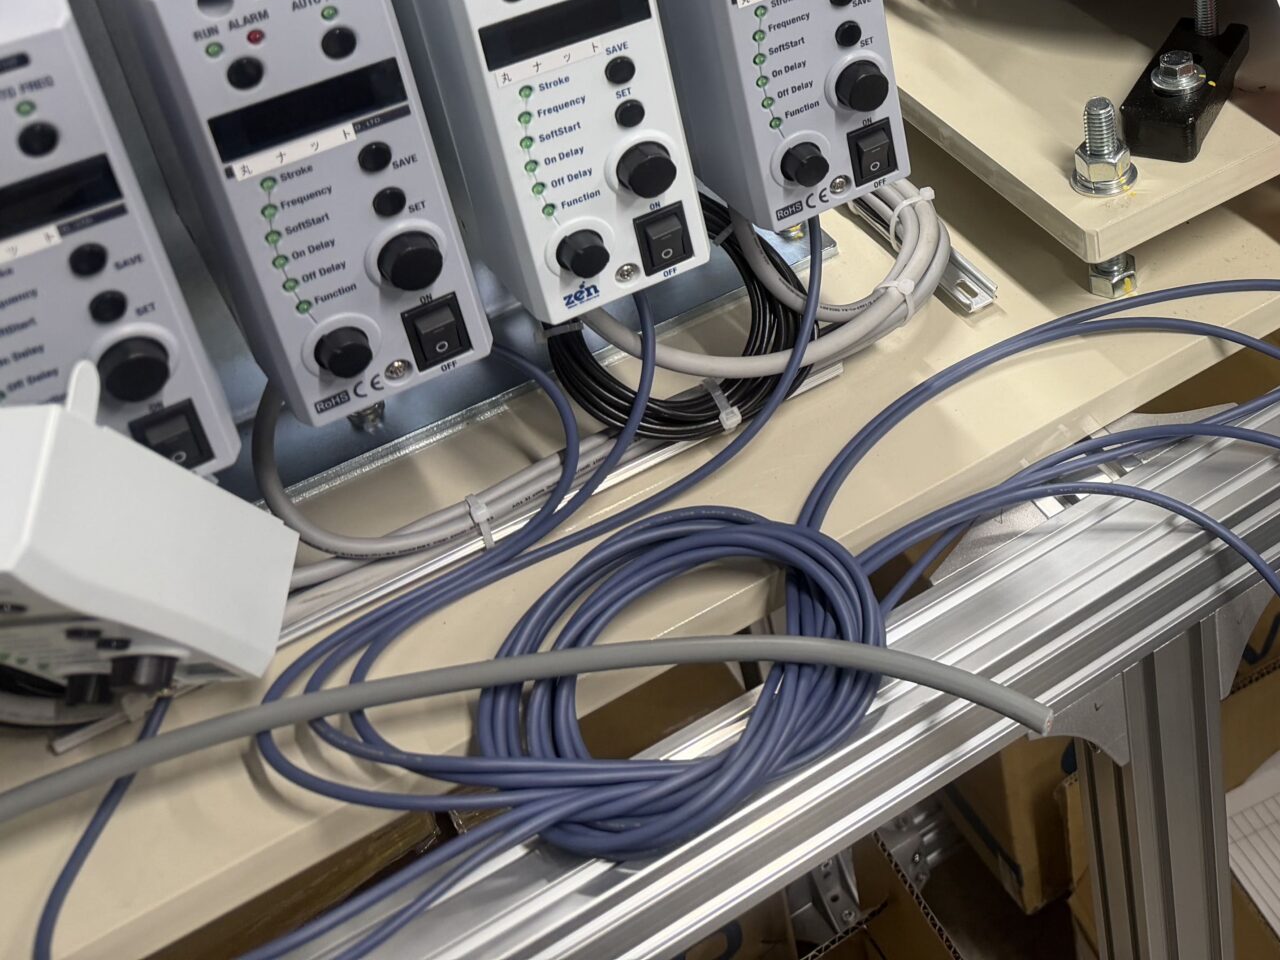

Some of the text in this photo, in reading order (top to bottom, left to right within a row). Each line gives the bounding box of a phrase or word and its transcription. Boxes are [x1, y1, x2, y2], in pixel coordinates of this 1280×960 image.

[228, 8, 270, 32] ALARM
[767, 12, 810, 32] Frequency
[193, 24, 220, 42] RUN
[860, 36, 874, 48] SET
[604, 41, 630, 56] SAVE
[768, 36, 805, 56] SoftStart
[771, 59, 807, 79] On Delay
[538, 74, 571, 92] Stroke
[777, 79, 814, 99] Off Delay
[615, 88, 633, 100] SET
[537, 94, 587, 119] Frequency
[784, 100, 820, 120] Function
[862, 117, 873, 126] ON
[538, 121, 582, 143] SoftStart
[391, 154, 418, 171] SAVE
[543, 146, 585, 167] On Delay
[279, 163, 314, 184] Stroke
[551, 166, 593, 189] Off Delay
[873, 178, 887, 190] OFF
[279, 184, 333, 211] Frequency
[408, 200, 427, 215] SET
[560, 189, 601, 210] Function
[649, 200, 661, 210] ON
[776, 201, 803, 221] RoHS
[284, 212, 330, 236] SoftStart
[291, 237, 336, 262] On Delay
[114, 253, 145, 271] SAVE
[301, 259, 347, 284] Off Delay
[662, 266, 678, 278] OFF
[313, 281, 358, 306] Function
[419, 292, 433, 305] ON
[563, 284, 600, 307] zen
[135, 302, 157, 317] SET
[440, 359, 458, 373] OFF
[315, 392, 350, 413] RoHS
